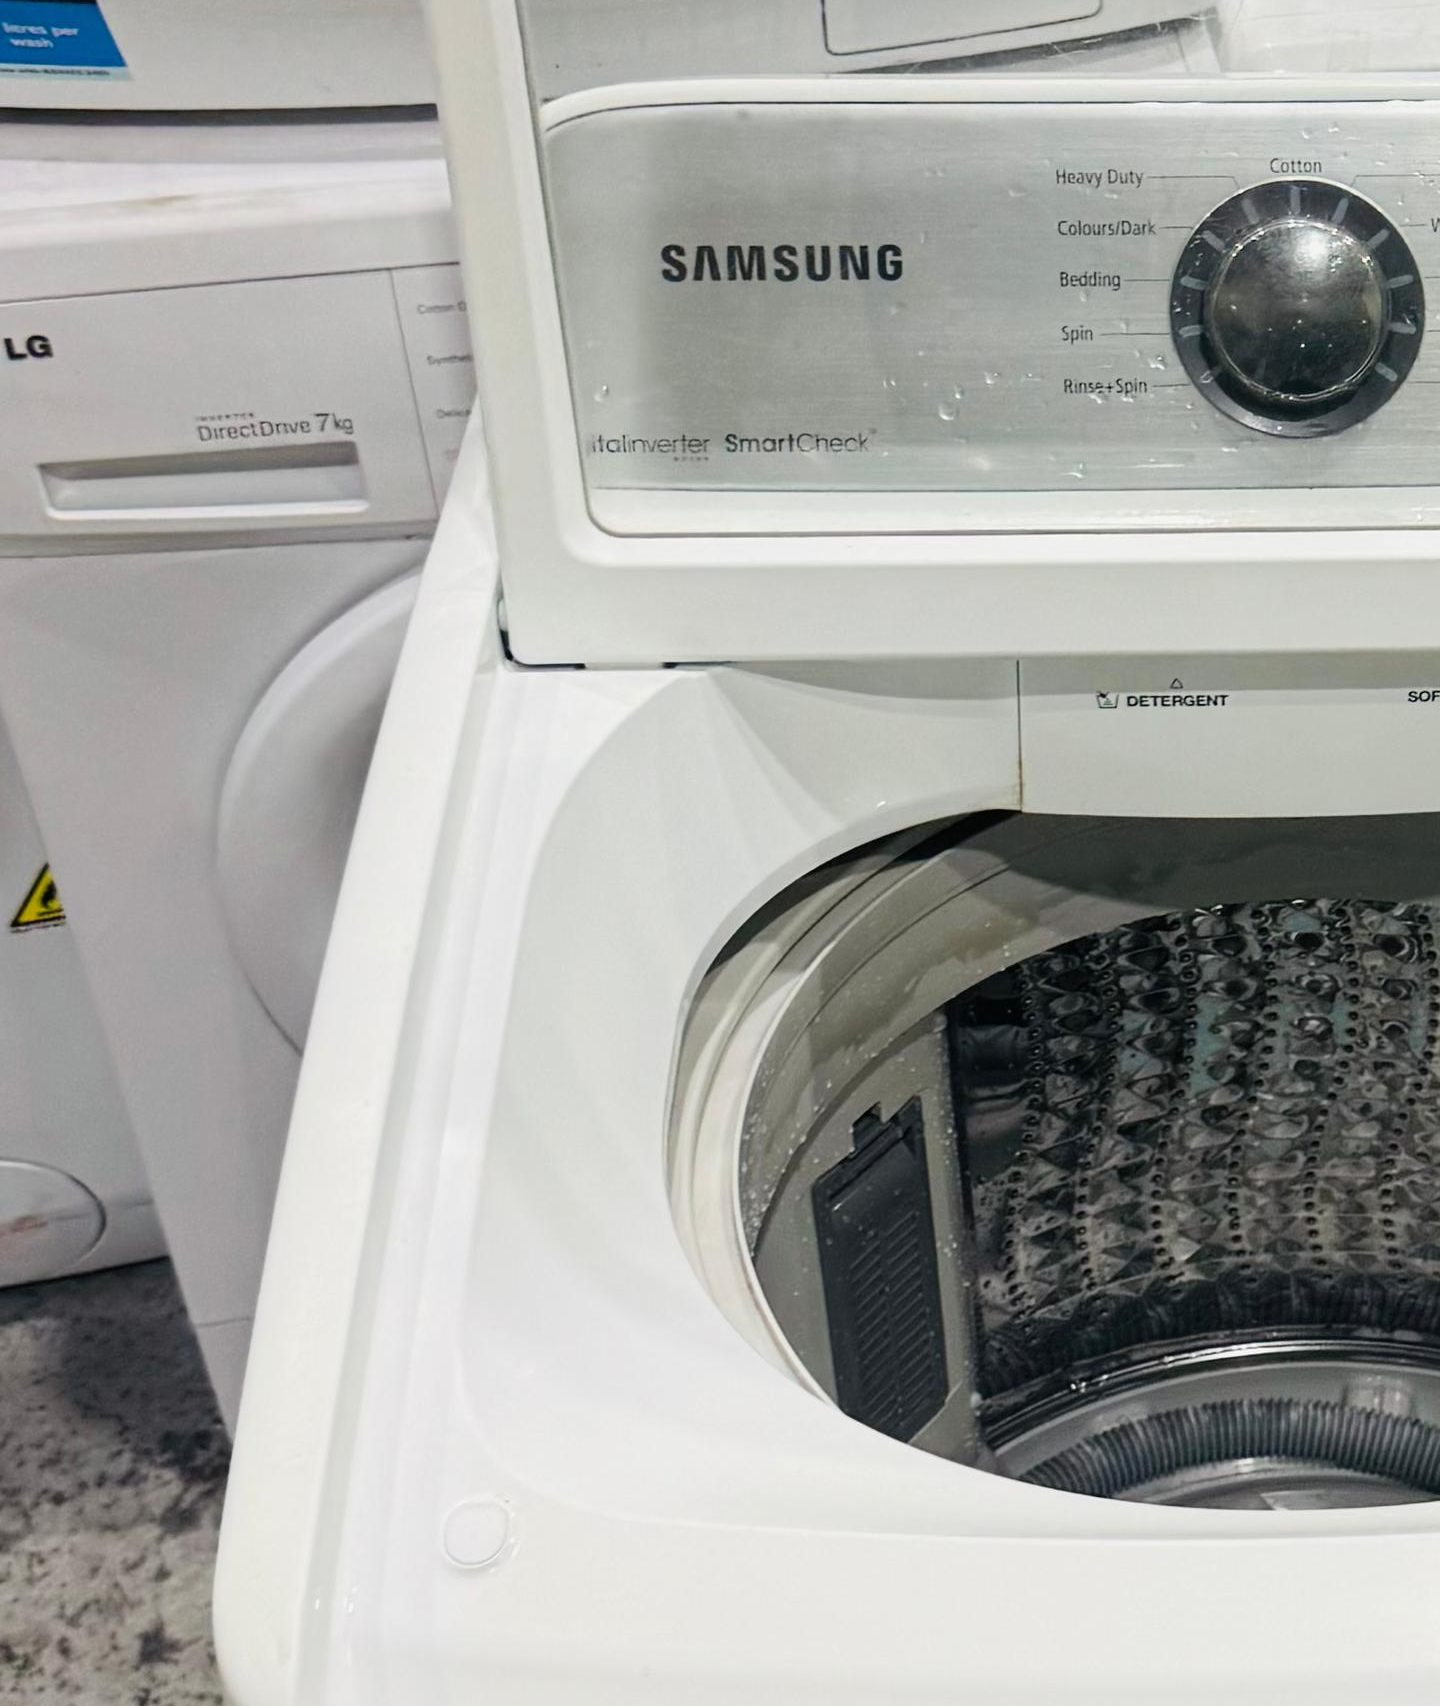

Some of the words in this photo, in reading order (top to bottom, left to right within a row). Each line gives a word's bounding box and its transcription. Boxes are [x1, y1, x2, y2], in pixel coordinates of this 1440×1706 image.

[10, 38, 54, 49] wash
[1269, 158, 1323, 175] Cotton
[1055, 169, 1103, 188] Heavy
[1108, 169, 1145, 188] Duty
[1057, 219, 1157, 237] Colours/Dark
[660, 244, 904, 283] SAMSUNG
[1059, 271, 1122, 290] Bedding
[1061, 325, 1094, 344] Spin
[4, 334, 54, 361] LG
[1063, 378, 1149, 397] Rinse+Spin
[197, 420, 312, 442] DirectDrive
[588, 433, 710, 454] italinverter
[1126, 693, 1230, 708] DETERGENT
